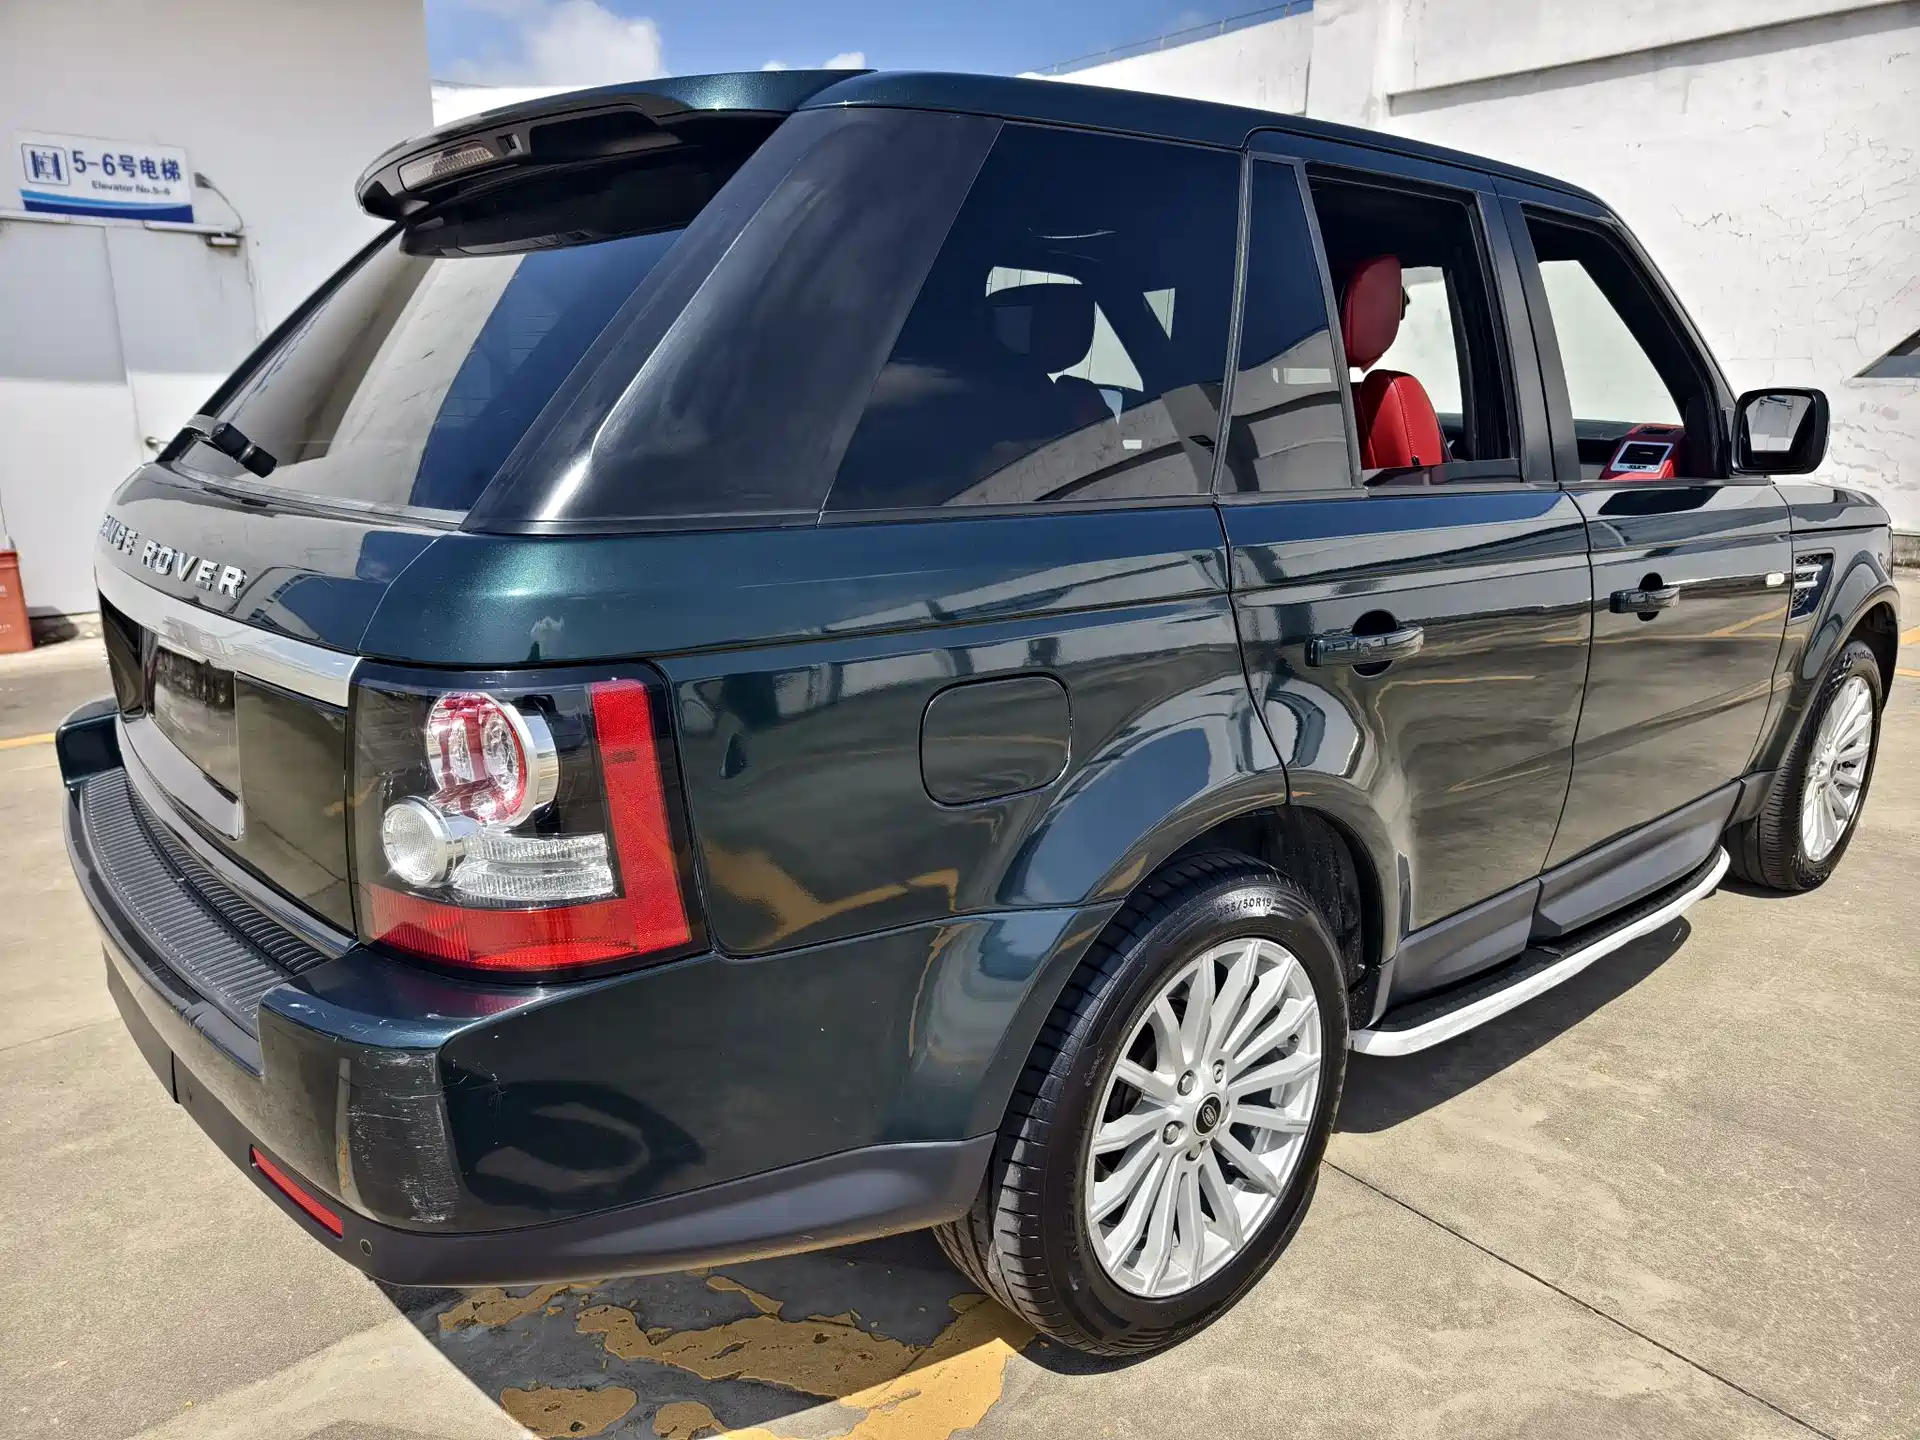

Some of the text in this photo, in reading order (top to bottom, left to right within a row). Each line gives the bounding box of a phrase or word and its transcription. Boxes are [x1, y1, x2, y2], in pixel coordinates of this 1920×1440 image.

[72, 150, 181, 182] 5-6号电梯
[91, 180, 133, 192] Elevator
[140, 539, 246, 600] ROVER
